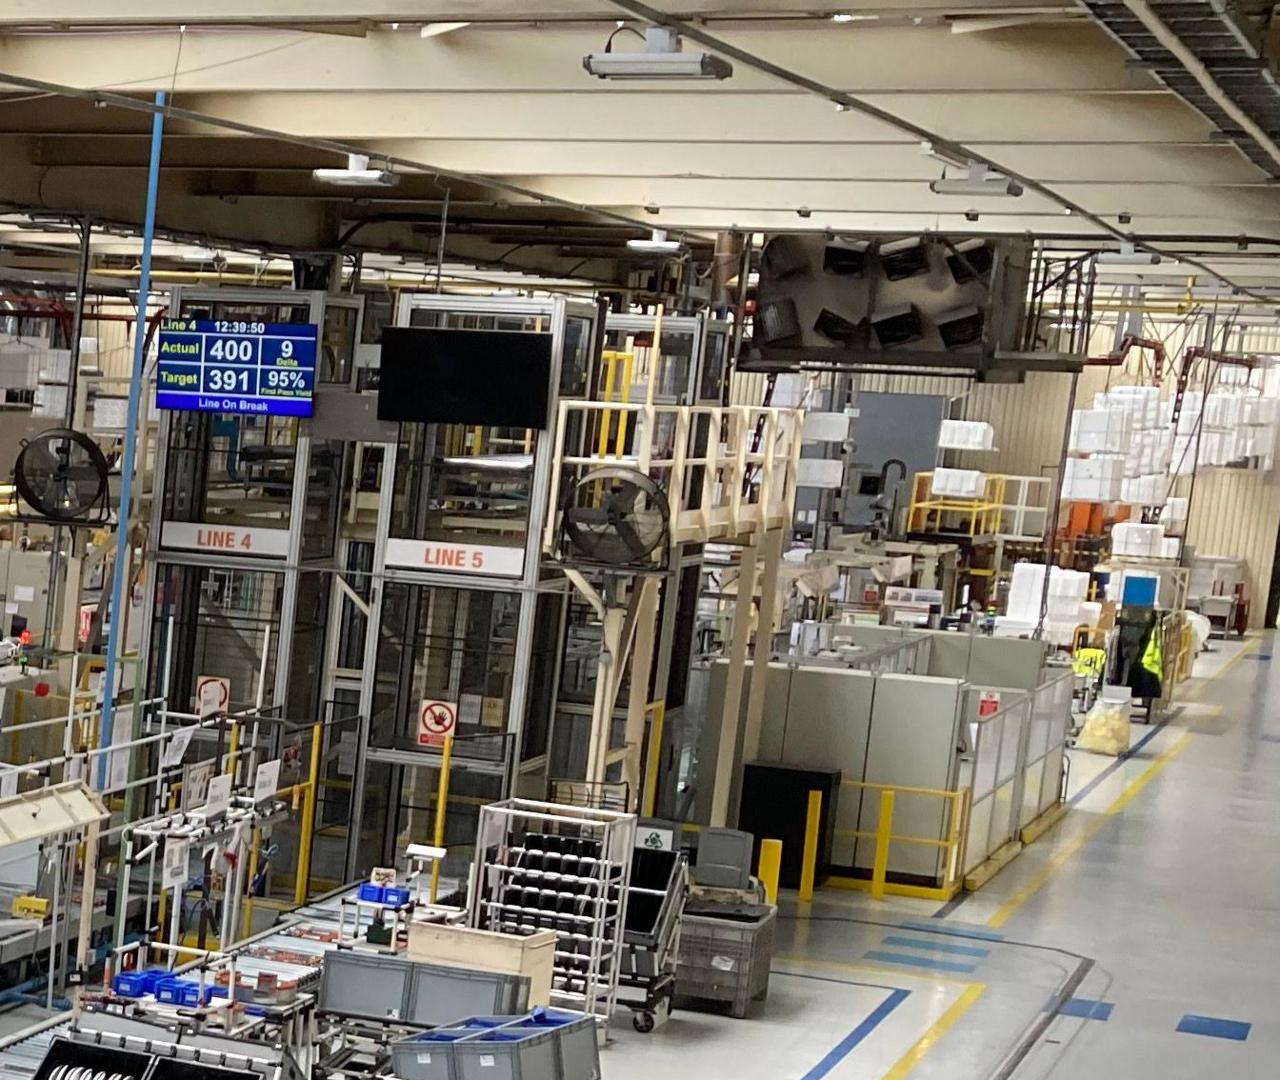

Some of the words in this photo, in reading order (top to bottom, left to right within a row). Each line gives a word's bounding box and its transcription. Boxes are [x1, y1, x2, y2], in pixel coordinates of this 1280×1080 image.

[160, 319, 186, 331] Line
[188, 320, 197, 331] 4
[214, 321, 266, 334] 12:39:50
[160, 342, 199, 354] Actual
[209, 339, 253, 361] 400
[281, 340, 293, 358] 9
[160, 371, 198, 386] Target
[209, 369, 249, 392] 391
[268, 371, 306, 389] 95%
[198, 398, 220, 408] Line
[222, 399, 237, 409] On
[239, 400, 269, 411] Break
[197, 529, 236, 548] LINE
[240, 534, 252, 550] 4
[424, 547, 466, 568] LINE
[471, 552, 484, 569] 5
